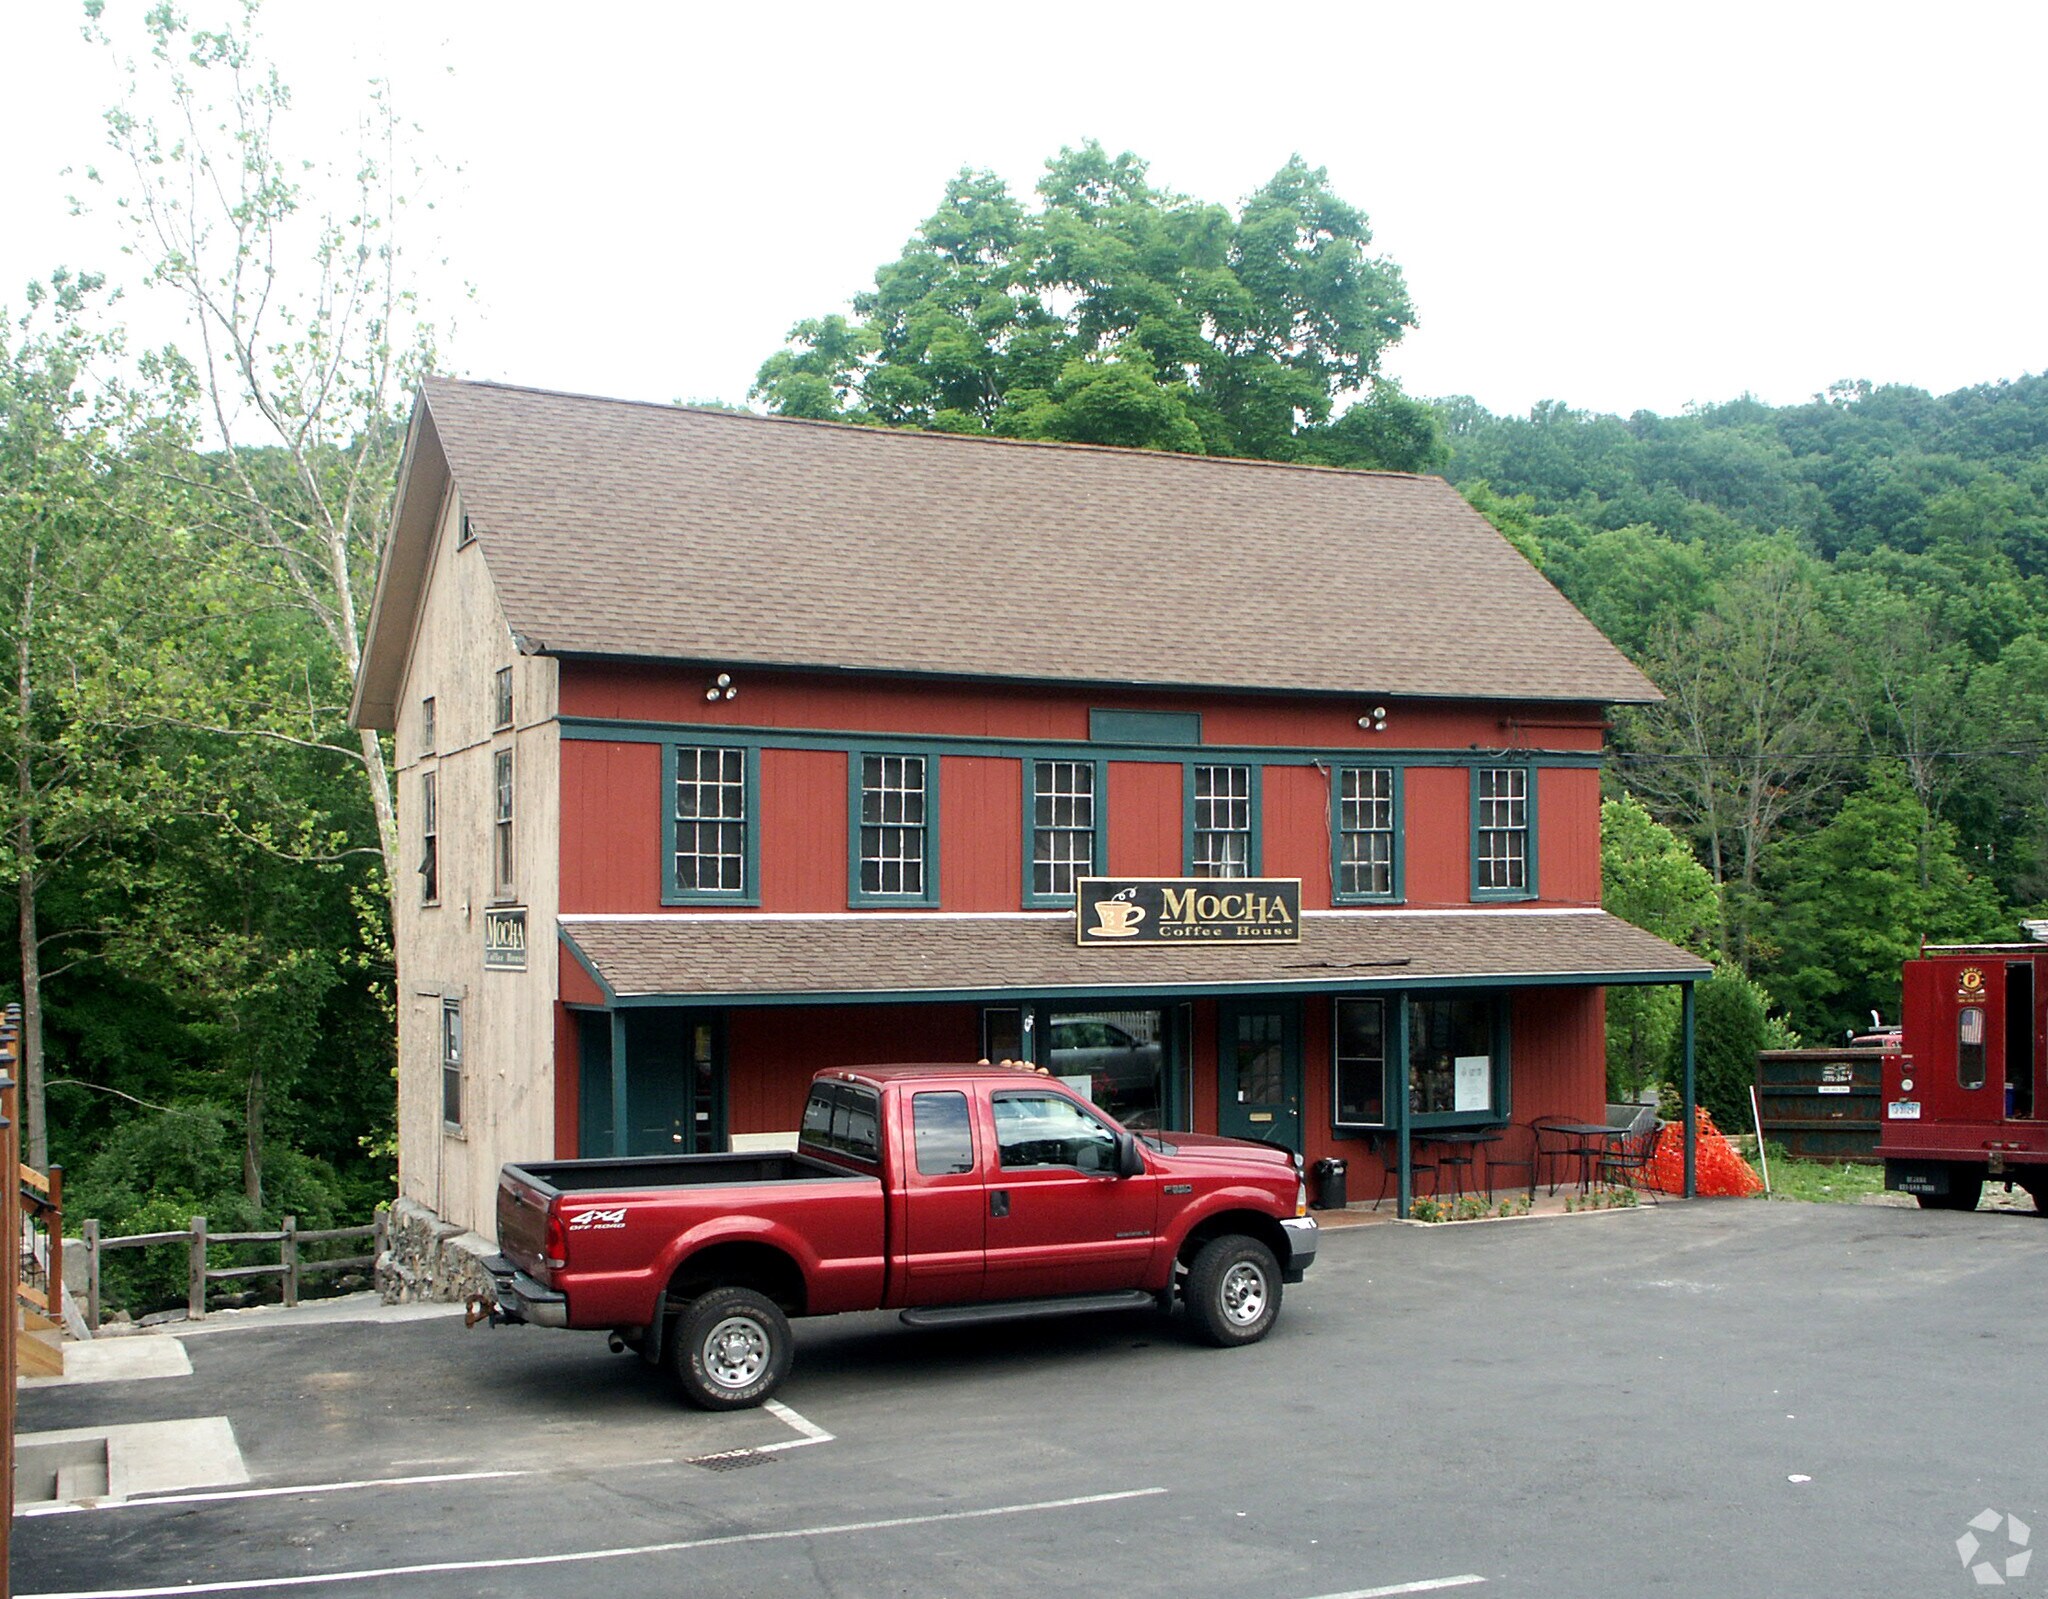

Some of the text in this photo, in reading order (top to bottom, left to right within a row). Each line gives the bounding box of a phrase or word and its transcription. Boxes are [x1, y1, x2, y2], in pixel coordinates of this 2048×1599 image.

[1158, 888, 1293, 924] MOCHA
[487, 916, 525, 949] MOCHA
[1159, 926, 1292, 936] Coffee House
